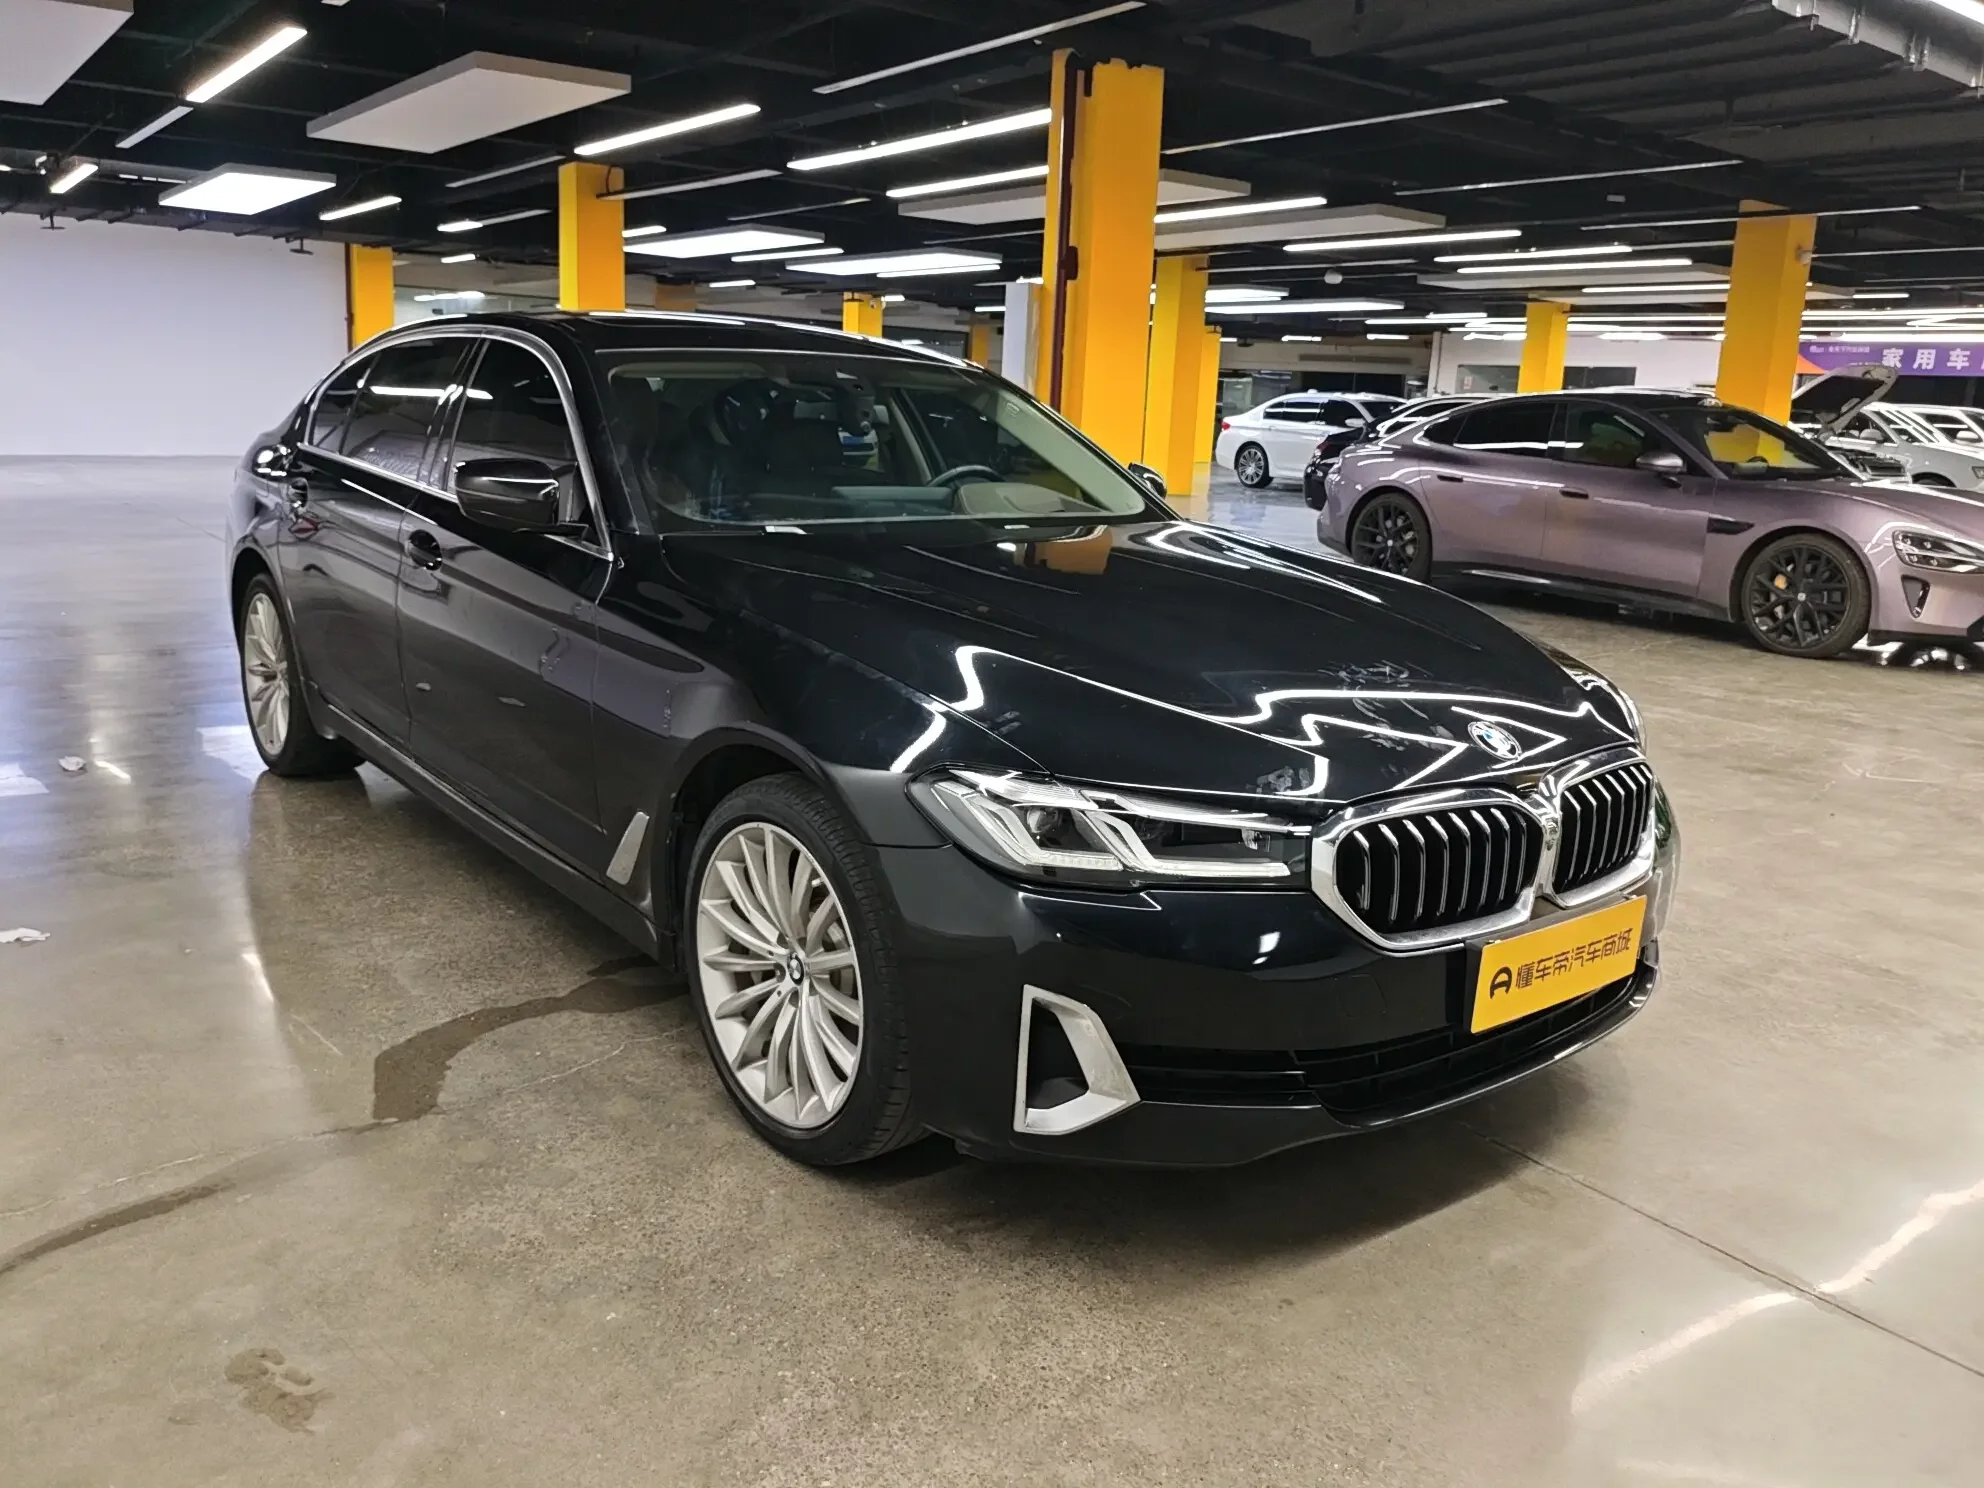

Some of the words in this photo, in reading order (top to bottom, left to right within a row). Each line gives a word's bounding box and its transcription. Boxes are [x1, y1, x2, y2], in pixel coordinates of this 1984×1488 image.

[1881, 348, 1984, 370] 家用车
[1515, 927, 1633, 989] 懂车帝汽车商城
